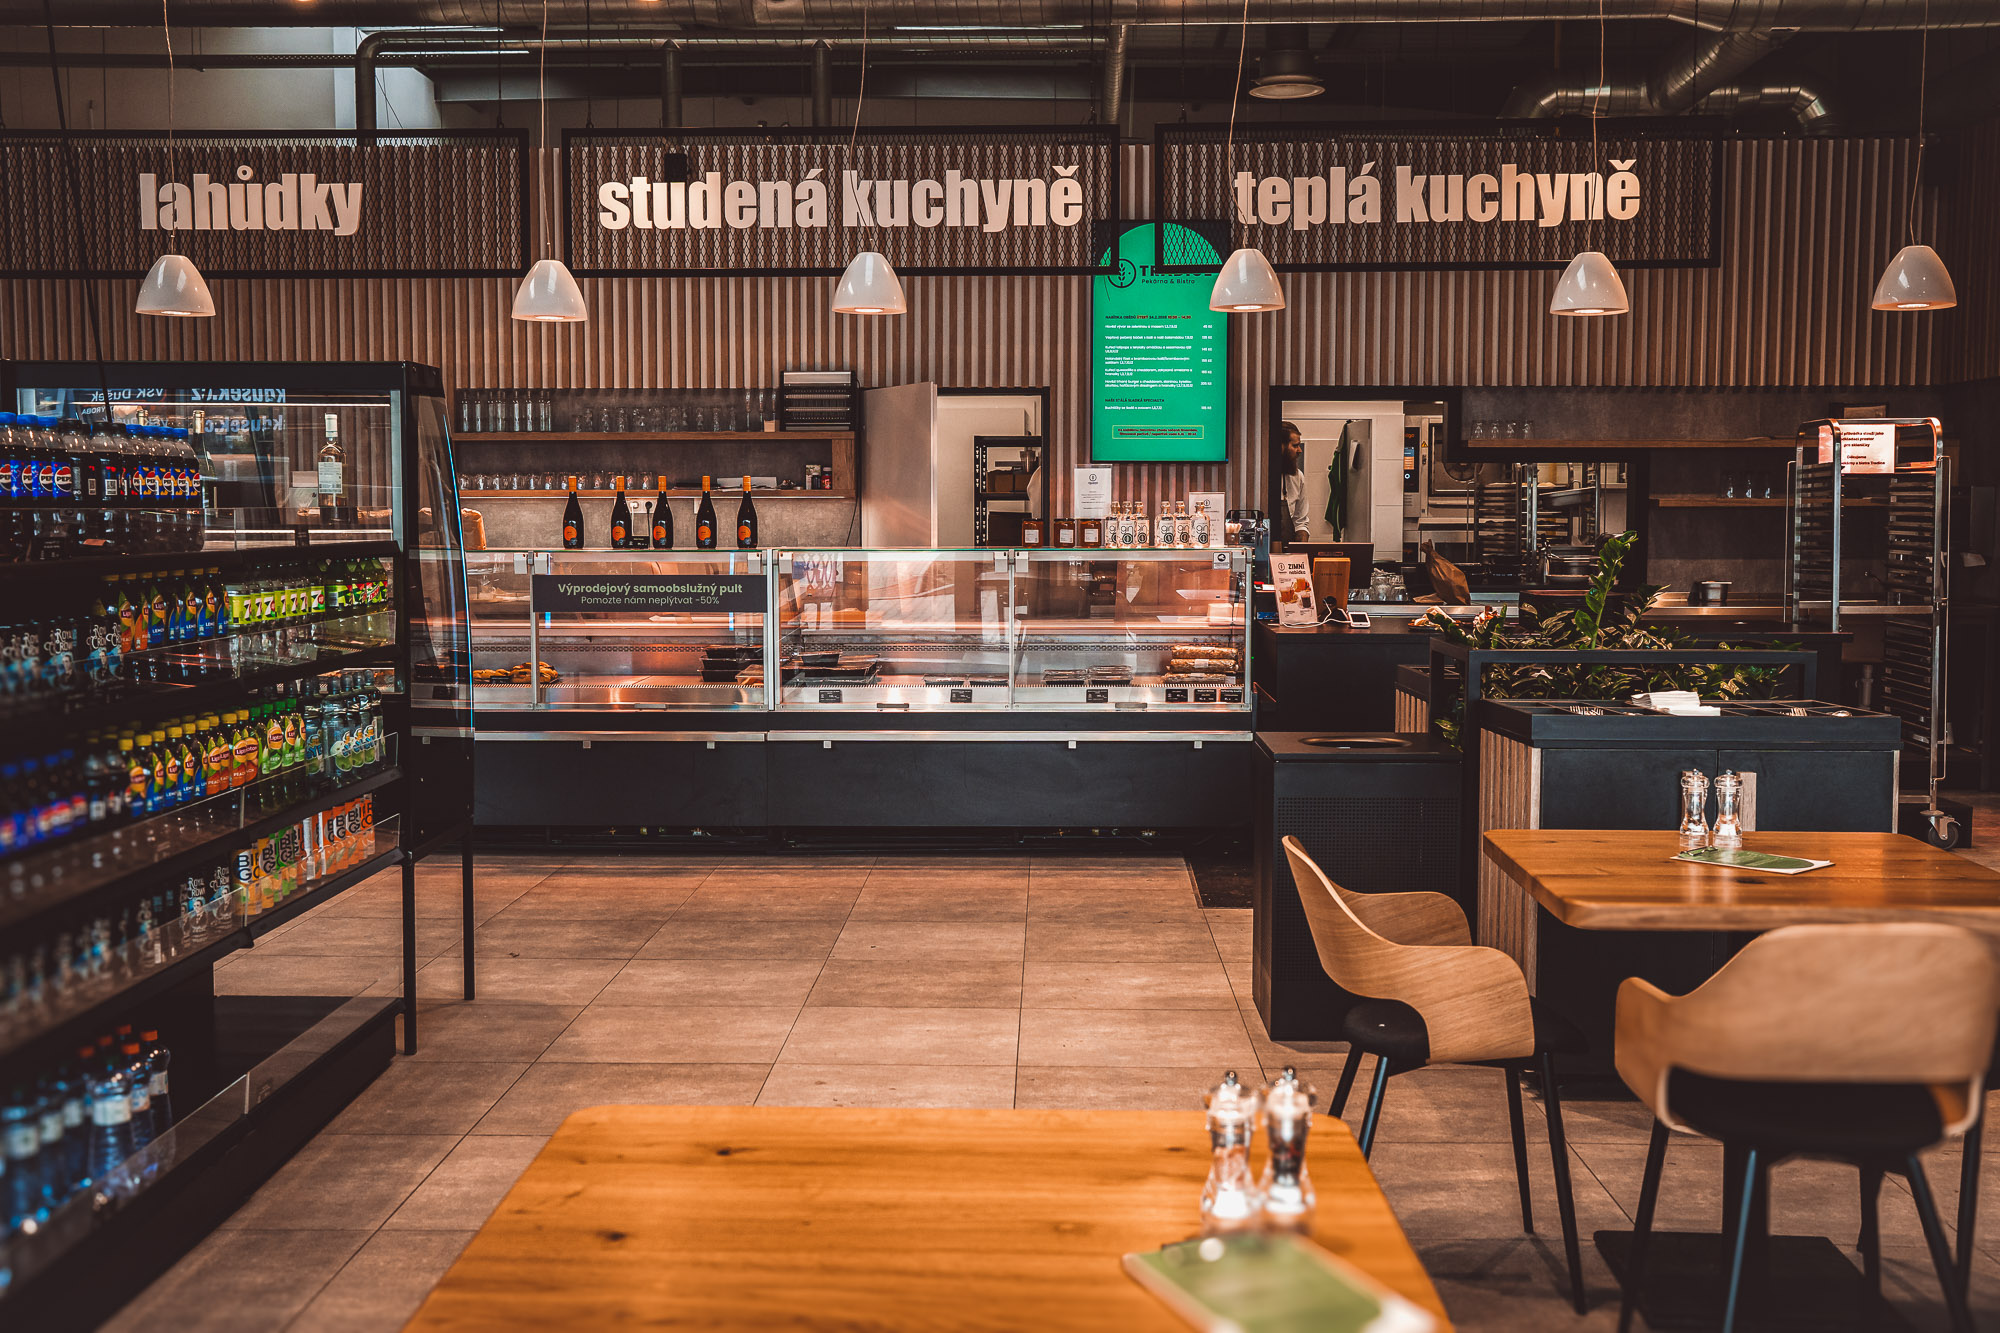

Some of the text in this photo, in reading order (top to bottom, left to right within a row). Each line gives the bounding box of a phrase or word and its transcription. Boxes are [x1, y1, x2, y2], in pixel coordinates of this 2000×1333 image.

[140, 165, 363, 236] lahůdky
[598, 165, 1083, 233] studená kuchyně
[1233, 158, 1641, 231] teplá kuchyně
[1288, 561, 1305, 570] ZIMNÍ
[558, 583, 743, 596] Výprodejový samoobslužný pult
[581, 596, 719, 606] Pomozte nám neplýtvat -50%
